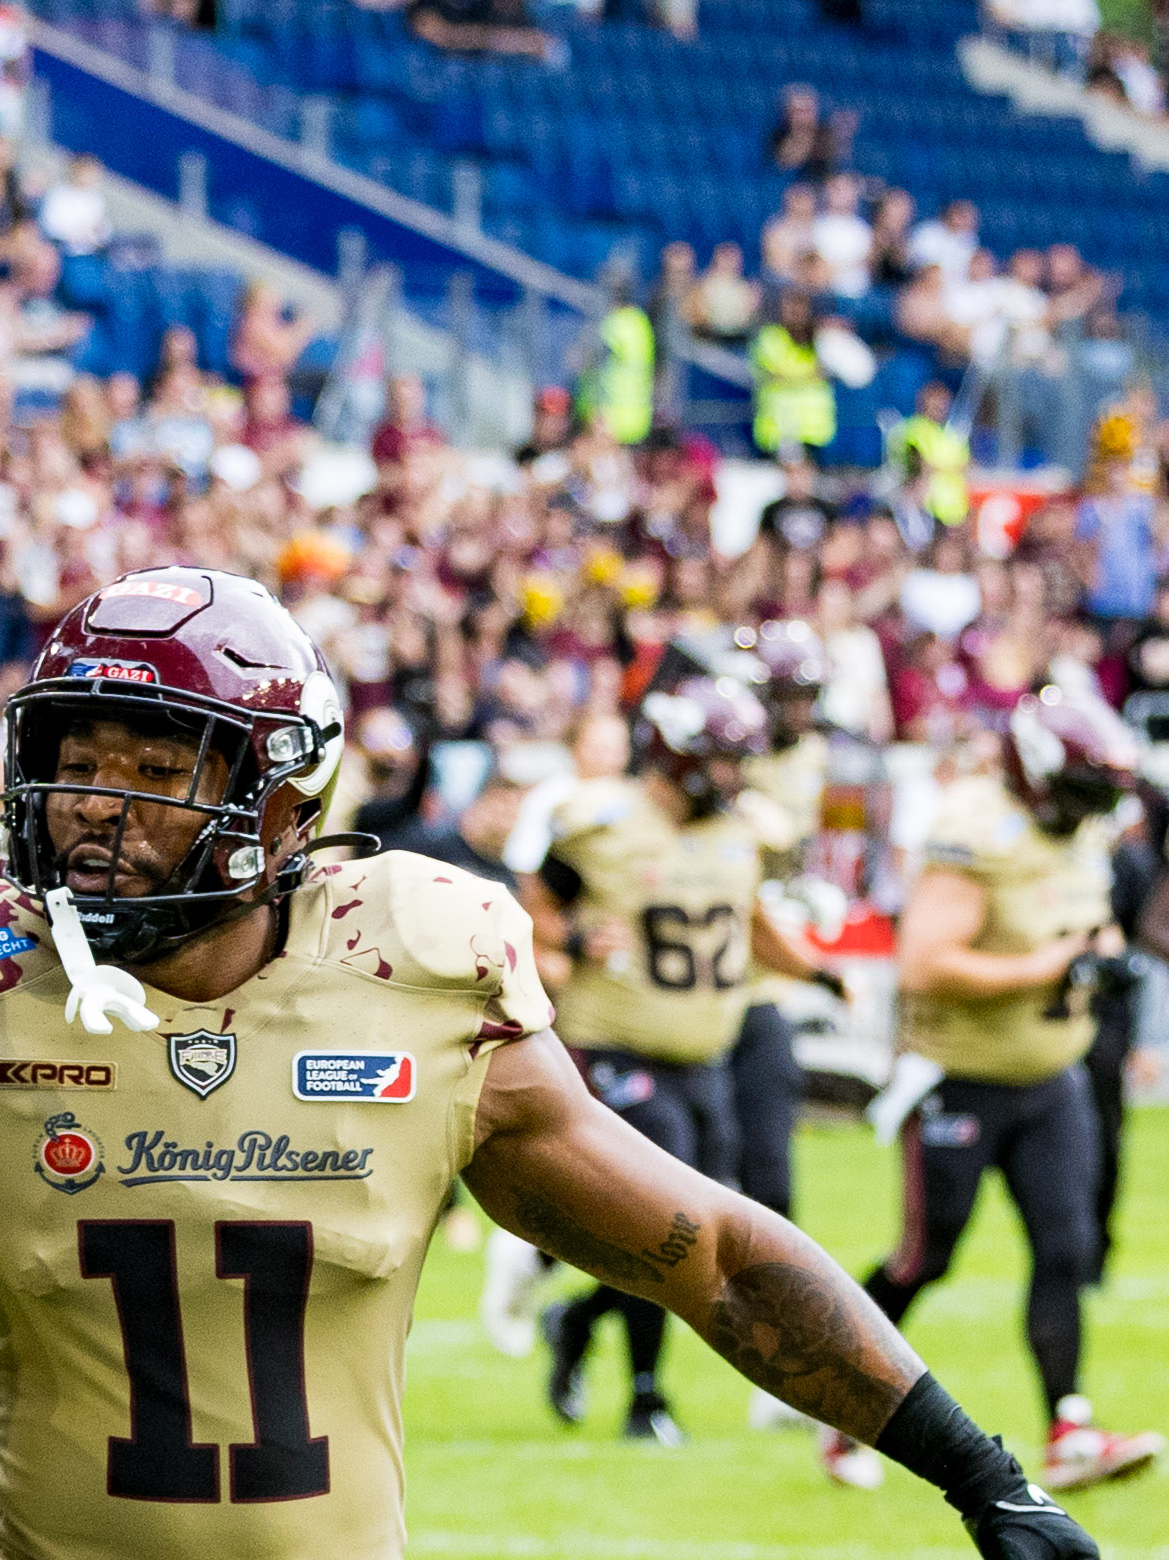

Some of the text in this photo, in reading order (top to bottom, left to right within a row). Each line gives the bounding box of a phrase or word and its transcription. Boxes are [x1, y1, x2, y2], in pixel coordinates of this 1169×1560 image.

[107, 667, 149, 682] GAZI
[640, 905, 741, 990] 62
[305, 1059, 365, 1071] EUROPEAN
[305, 1070, 348, 1081] LEAGUE
[305, 1081, 363, 1092] FOOTBALL
[117, 1130, 235, 1181] König
[233, 1130, 374, 1178] Pilsener
[77, 1219, 331, 1504] 11
